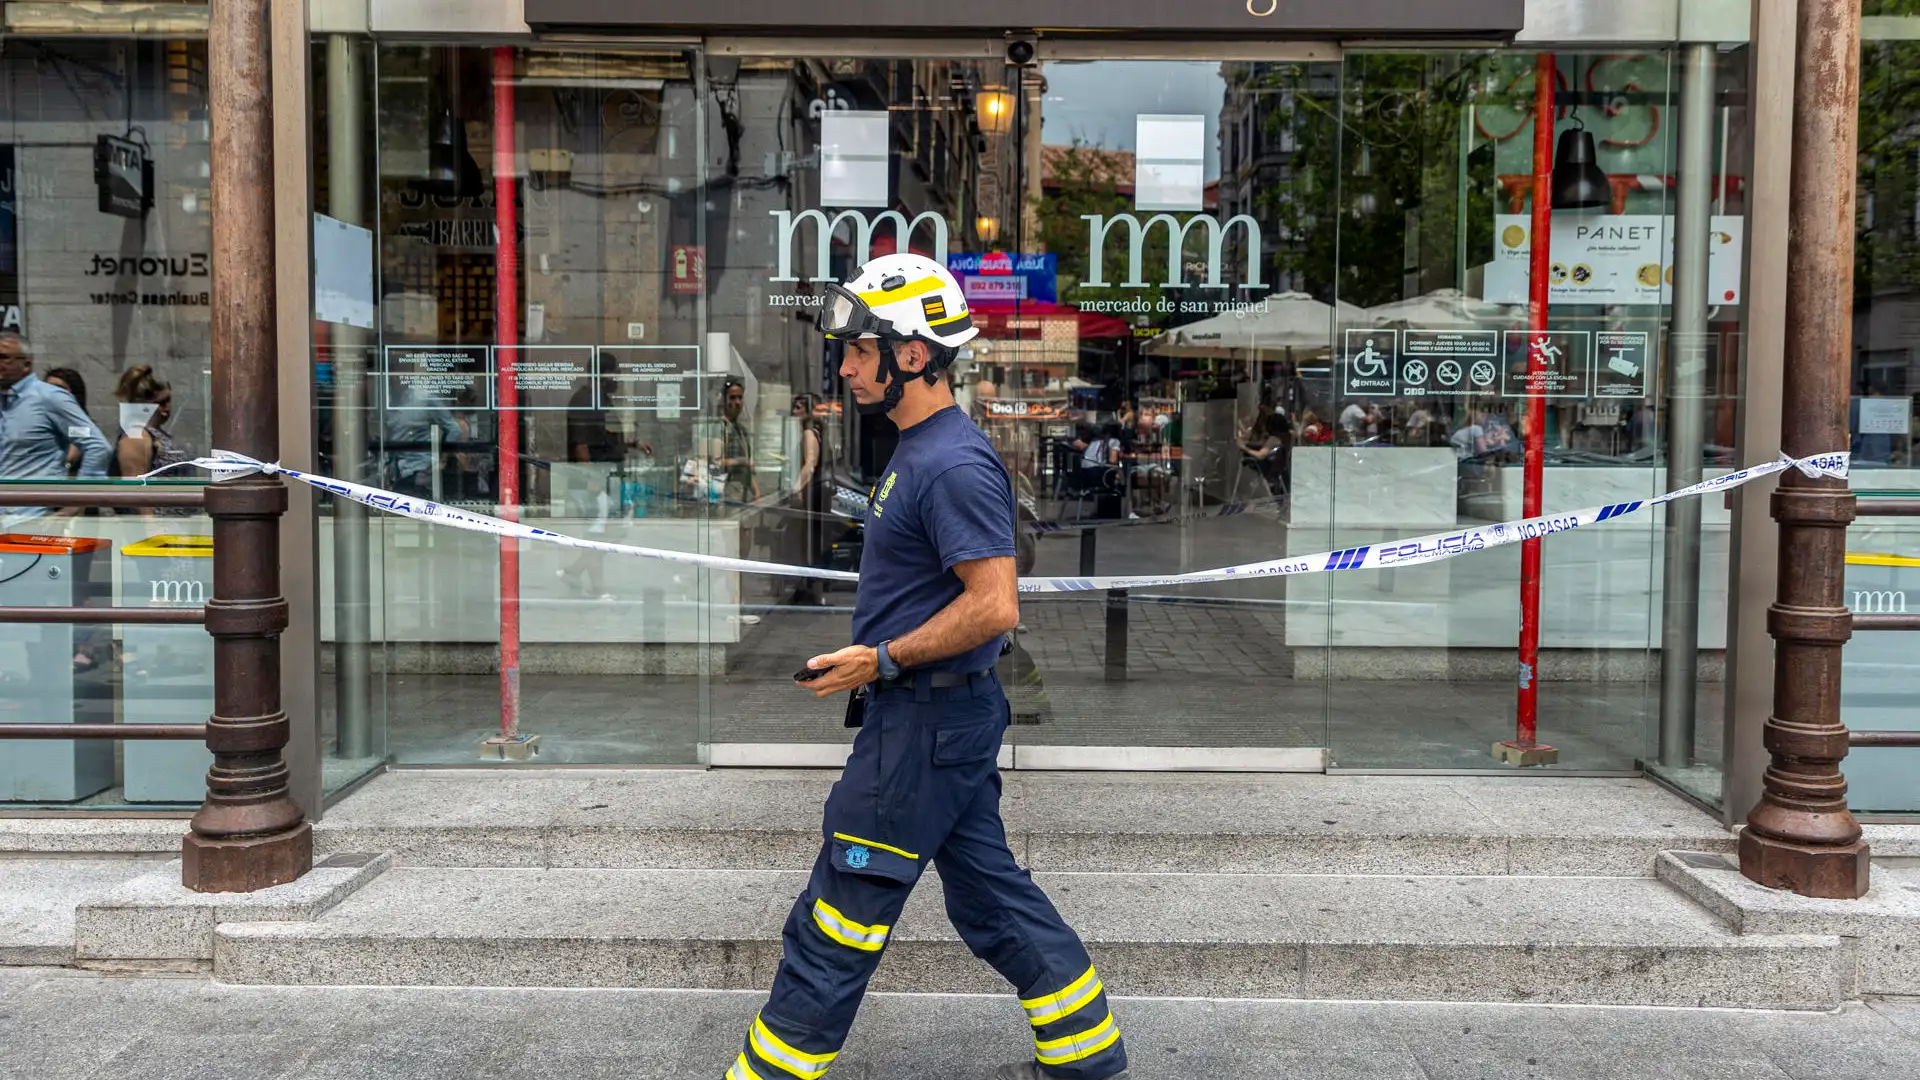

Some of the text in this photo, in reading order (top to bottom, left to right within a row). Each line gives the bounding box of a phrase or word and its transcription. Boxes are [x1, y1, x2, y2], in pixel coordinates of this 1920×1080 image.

[1577, 226, 1656, 240] PANET
[769, 294, 825, 306] merca
[1080, 296, 1270, 318] mercado de san miguel
[1517, 516, 1578, 540] NO PASAR
[1379, 532, 1485, 561] POLICÍA
